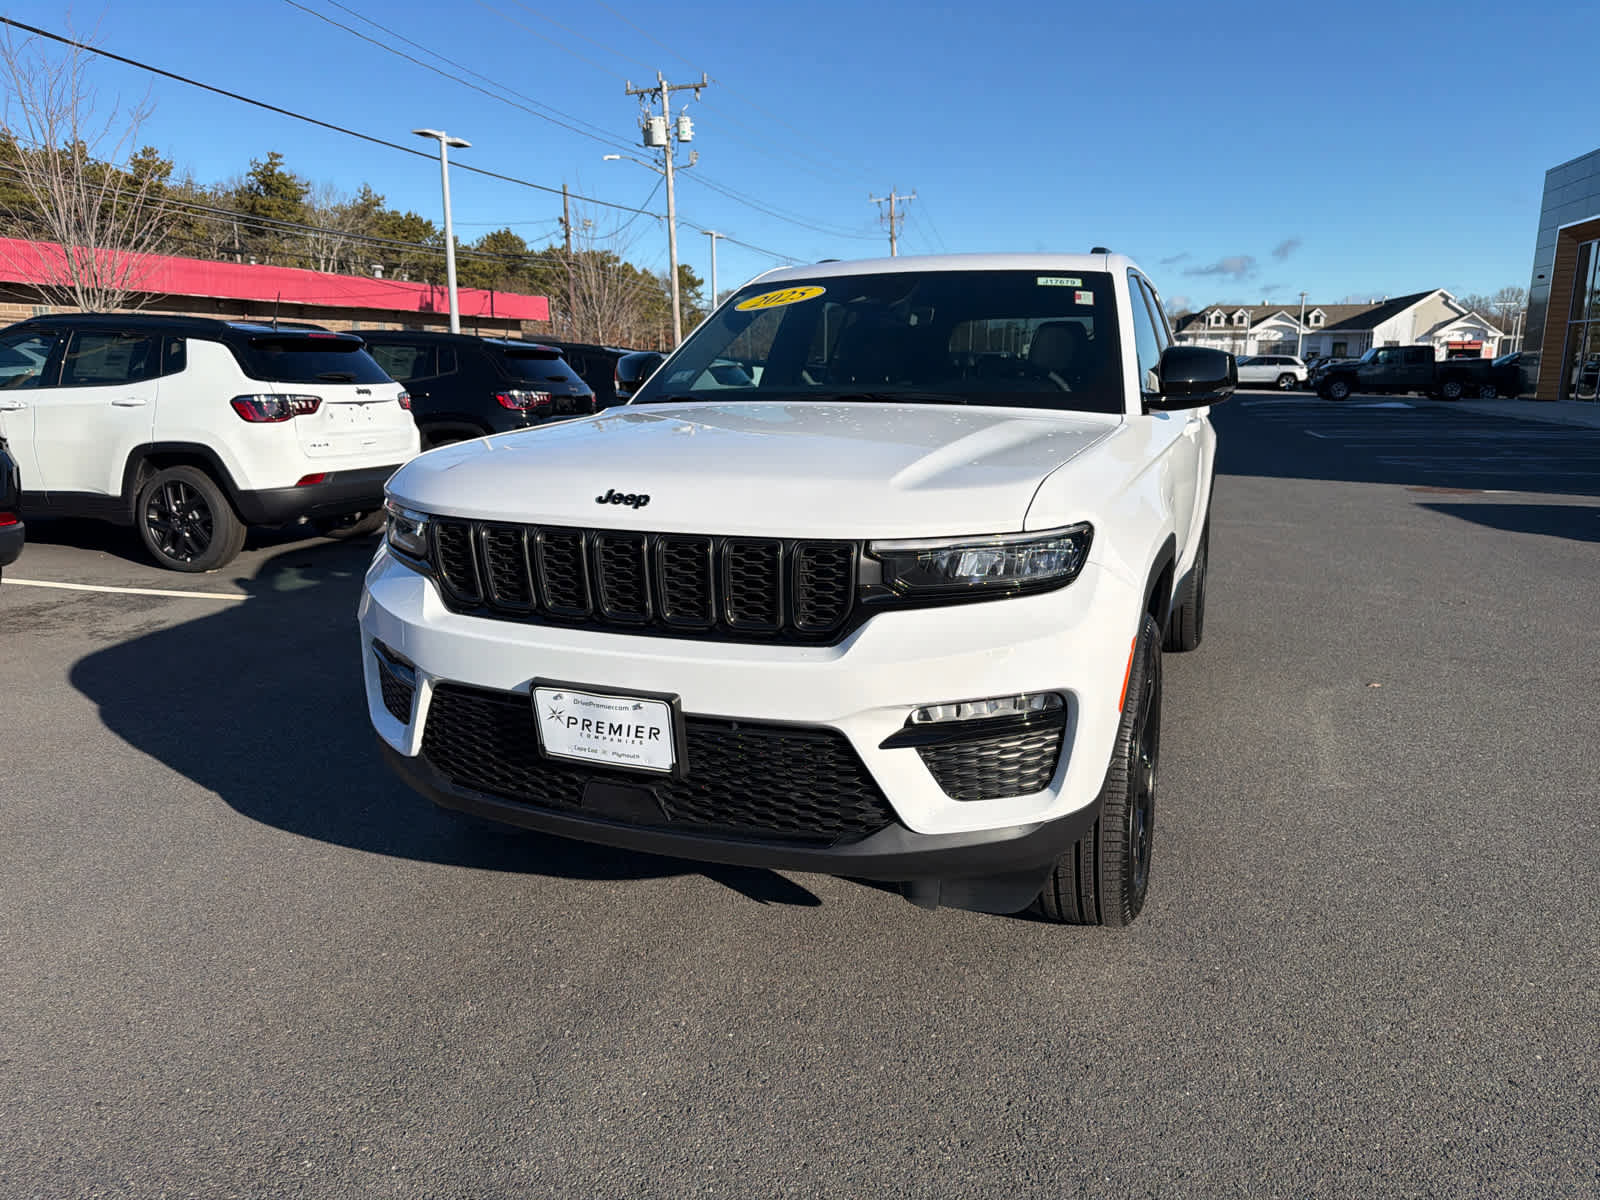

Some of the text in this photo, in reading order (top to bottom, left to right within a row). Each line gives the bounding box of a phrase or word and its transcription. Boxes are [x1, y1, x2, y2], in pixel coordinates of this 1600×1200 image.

[748, 288, 816, 308] 2025
[595, 489, 651, 509] Jeep
[566, 716, 661, 741] PREMIER
